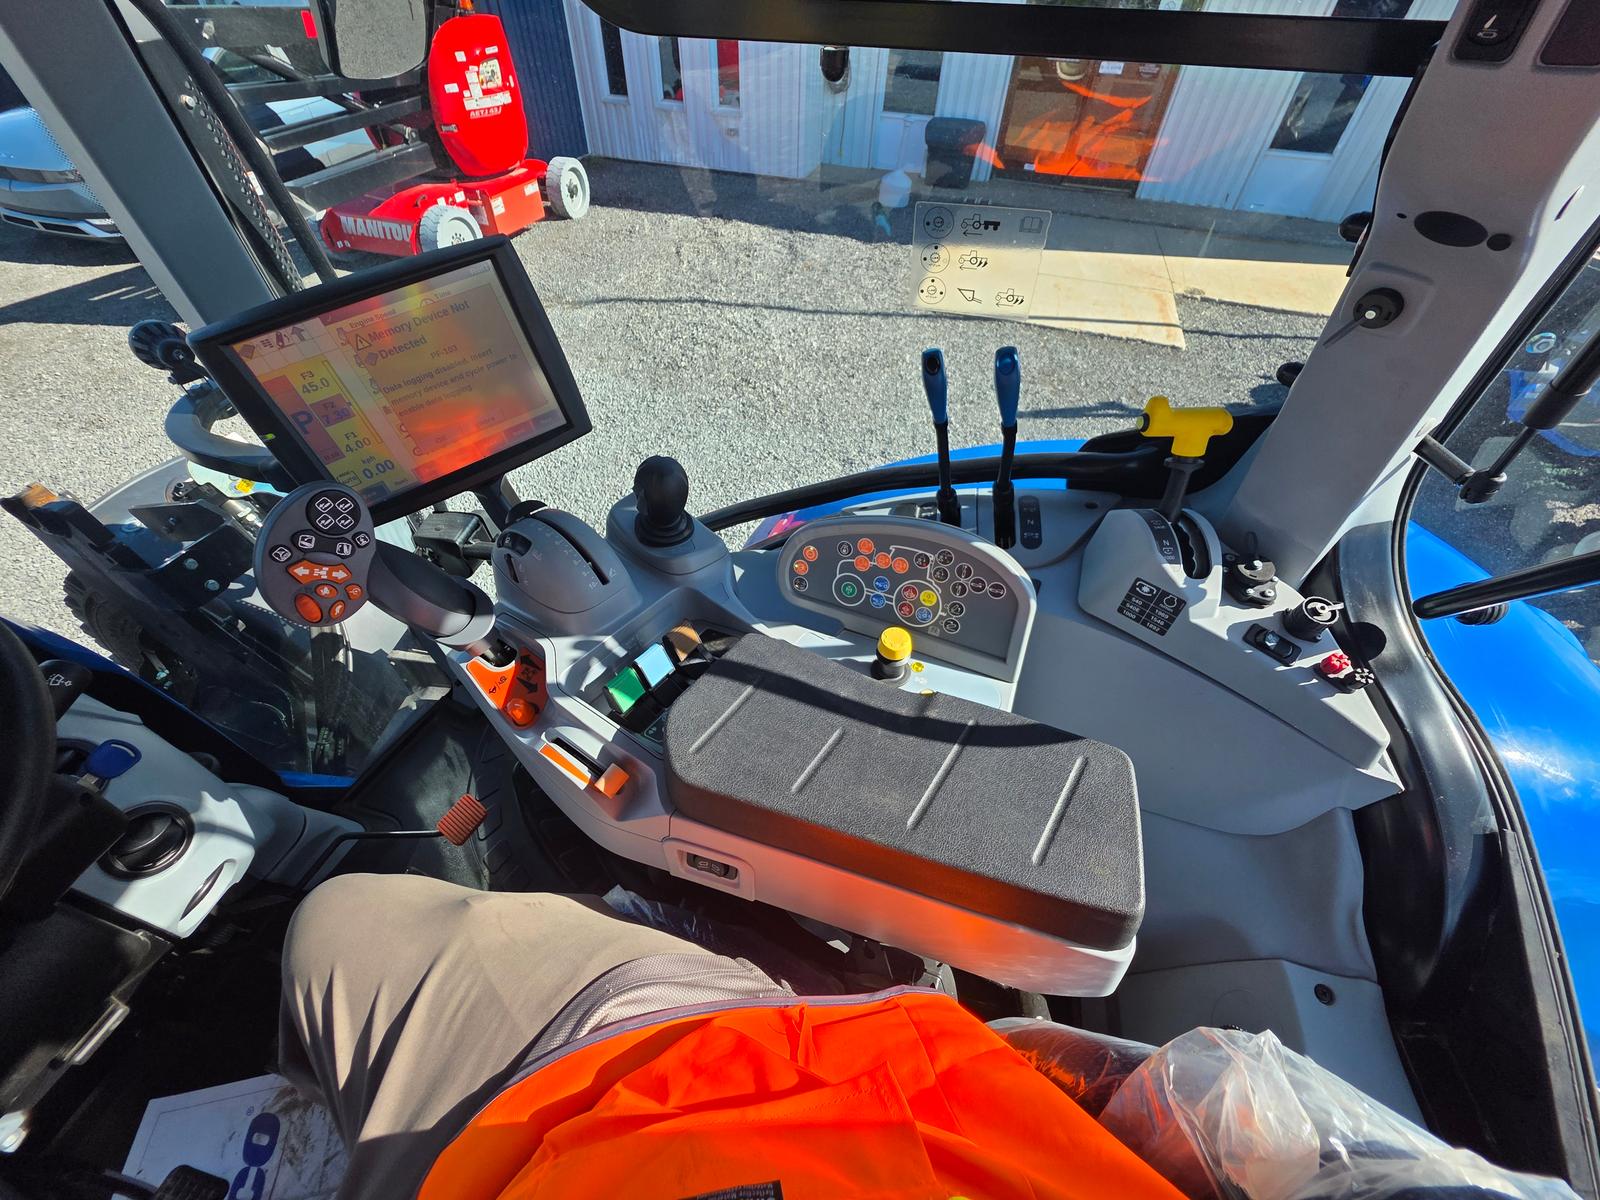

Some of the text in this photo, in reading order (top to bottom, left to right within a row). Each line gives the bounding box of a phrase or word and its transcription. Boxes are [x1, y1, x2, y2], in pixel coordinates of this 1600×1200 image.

[340, 215, 413, 243] MANITOU
[368, 299, 471, 343] Memory Device Not
[378, 335, 428, 360] Detected
[301, 370, 315, 381] F3
[302, 377, 331, 395] 45.0
[383, 383, 401, 393] Data
[290, 410, 314, 435] P
[344, 431, 358, 441] F1
[345, 436, 372, 454] 4.00
[362, 459, 395, 480] 0.00
[1162, 539, 1170, 547] N
[1123, 608, 1137, 620] 1000
